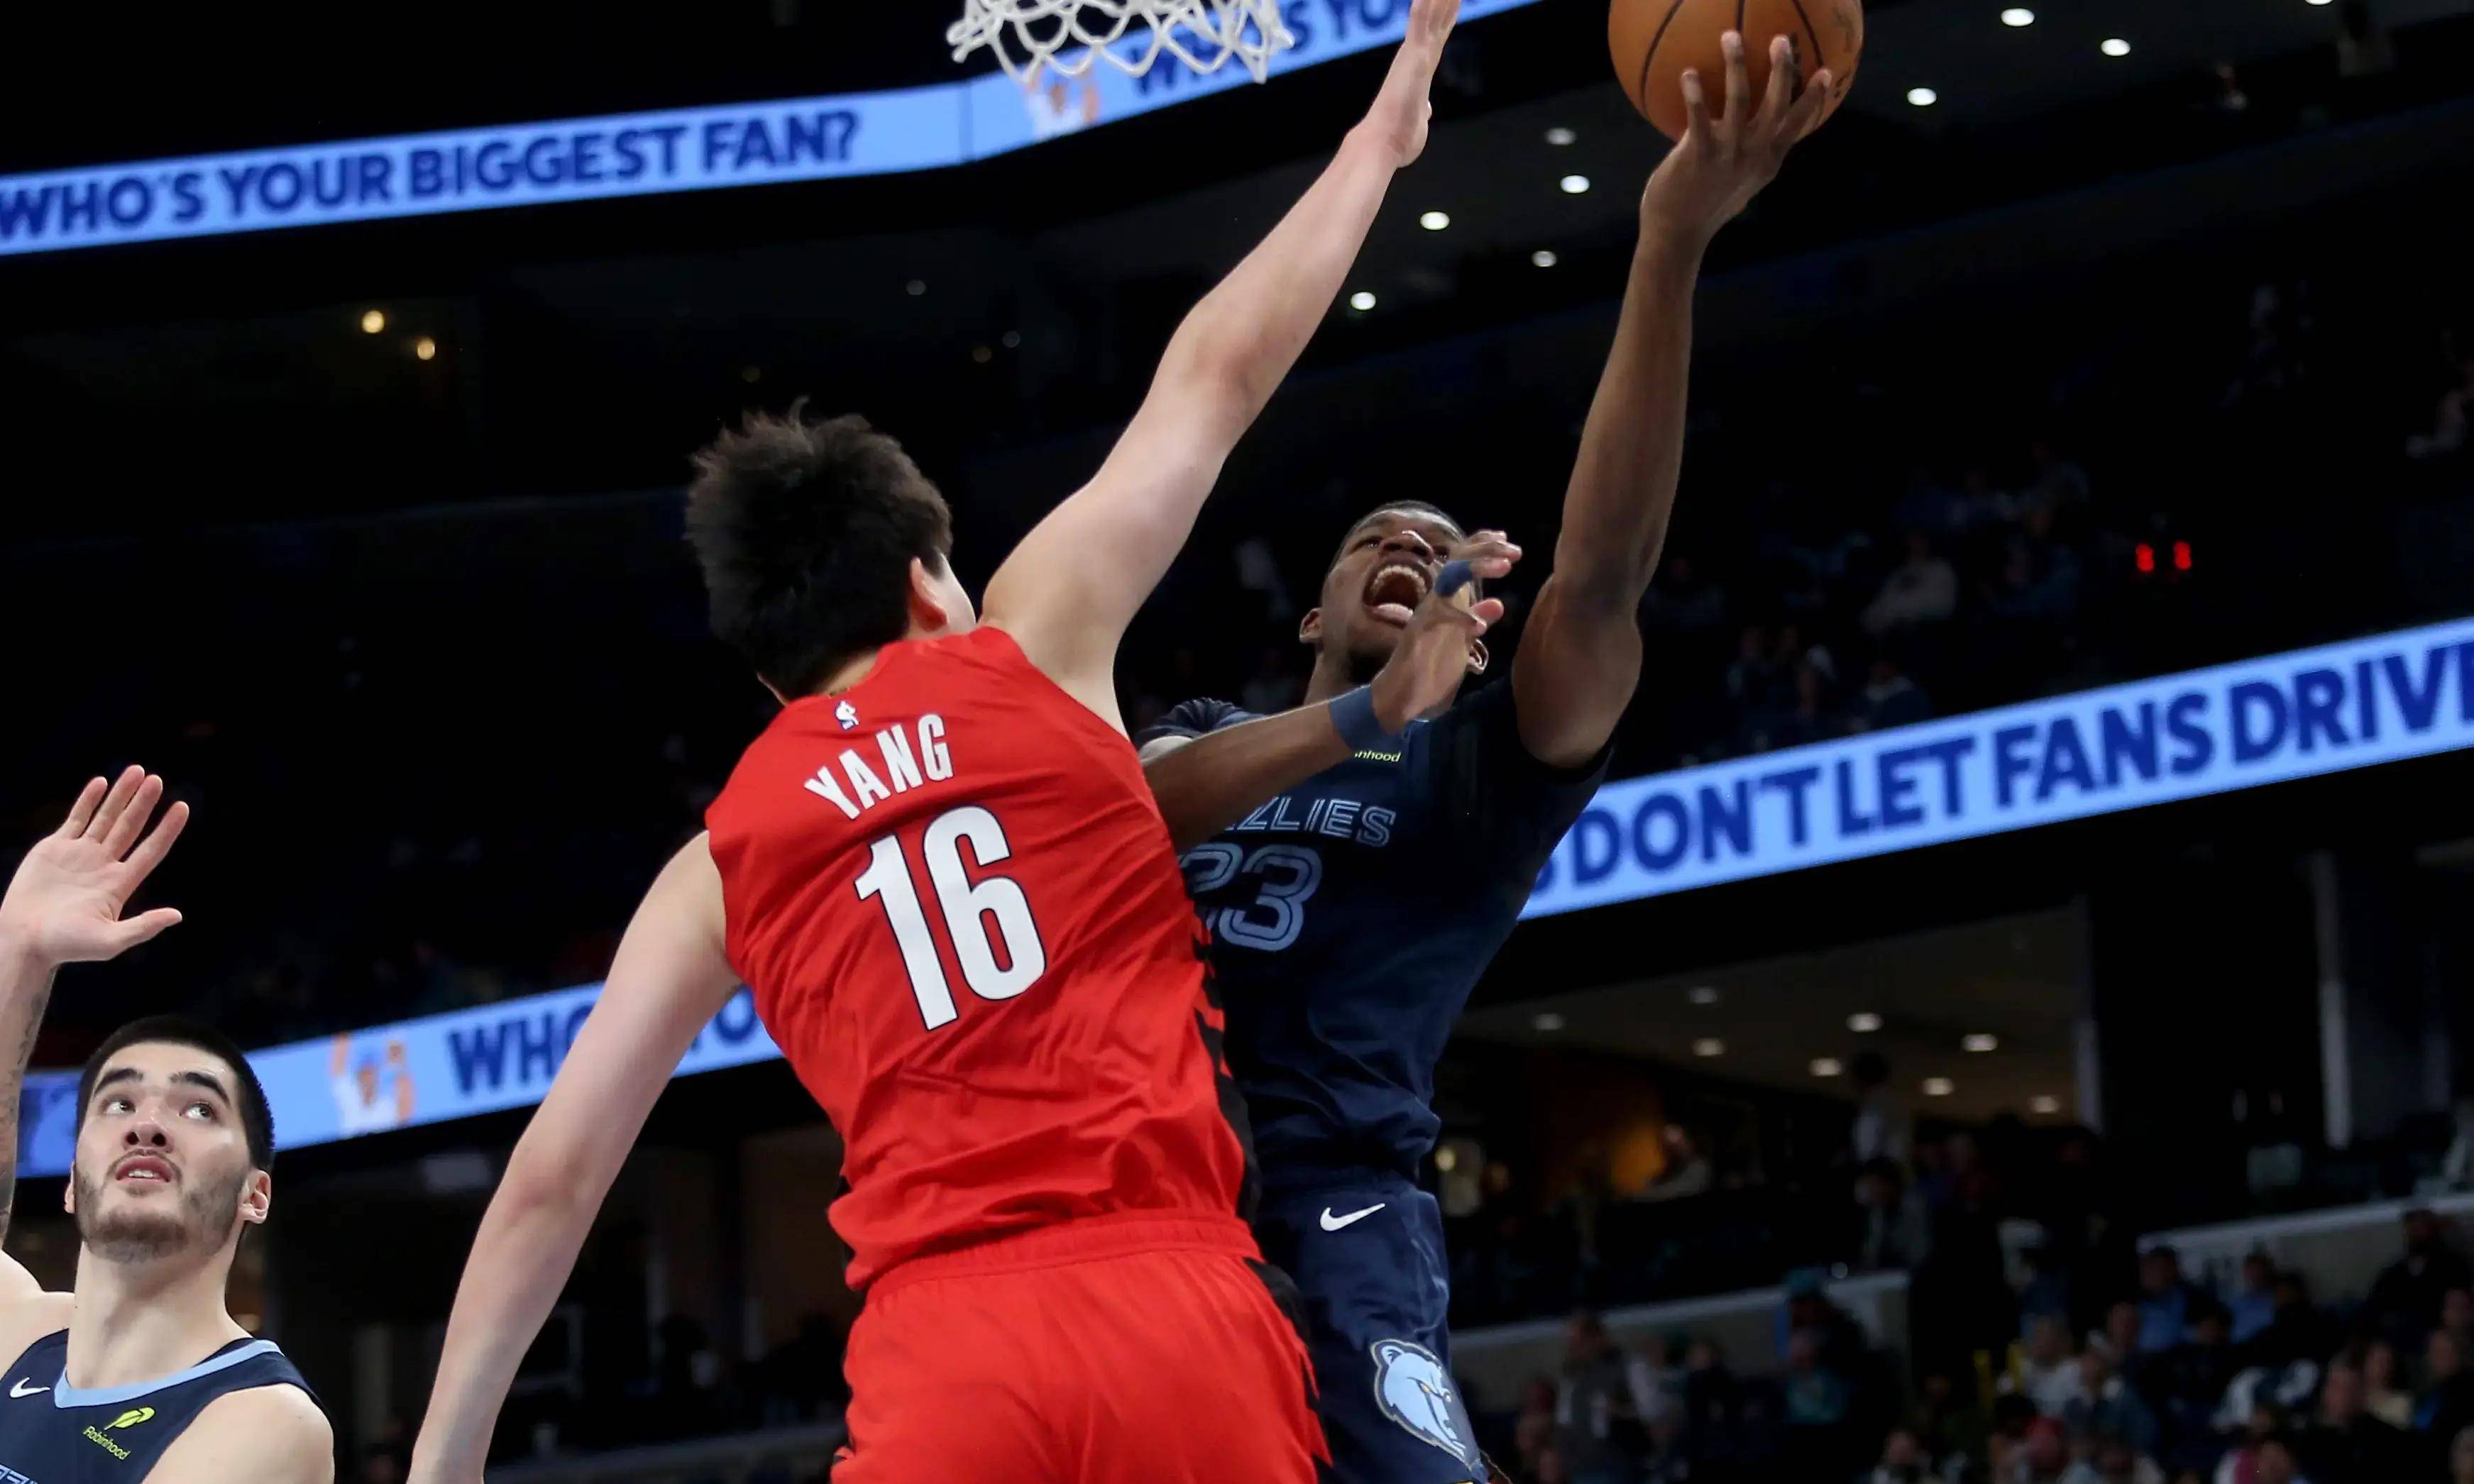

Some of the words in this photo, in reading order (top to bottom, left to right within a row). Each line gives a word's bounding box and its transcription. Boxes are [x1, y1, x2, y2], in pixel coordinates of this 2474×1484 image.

[0, 172, 203, 237] WHO'S
[221, 150, 393, 217] YOUR
[410, 125, 687, 199] BIGGEST
[702, 111, 860, 173] FAN?
[803, 713, 954, 820] YANG
[1225, 796, 1397, 848] ZLIES
[1837, 736, 1977, 840] LET
[1992, 691, 2217, 808] FANS
[854, 805, 1047, 1031] 16
[82, 1425, 131, 1461] Robinhood
